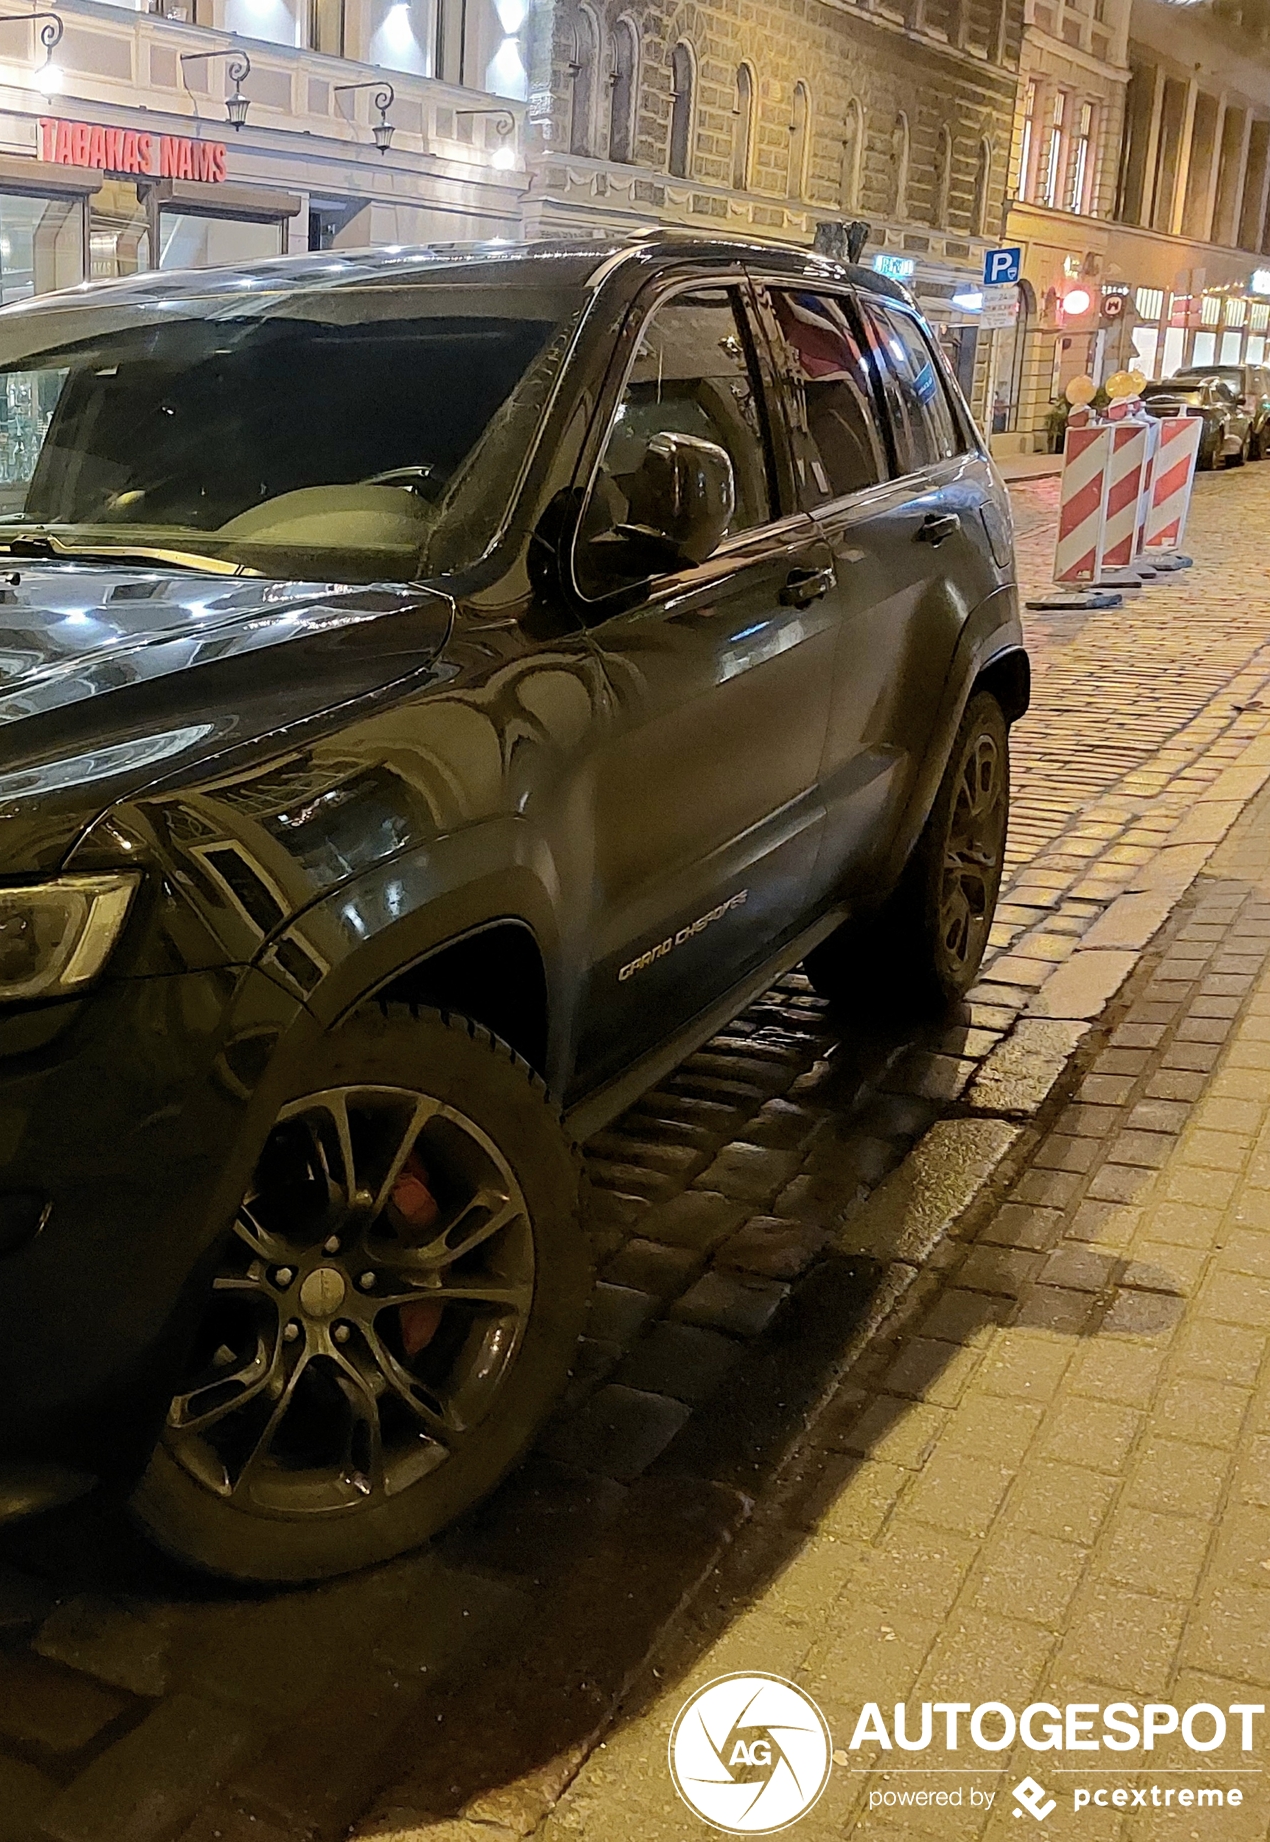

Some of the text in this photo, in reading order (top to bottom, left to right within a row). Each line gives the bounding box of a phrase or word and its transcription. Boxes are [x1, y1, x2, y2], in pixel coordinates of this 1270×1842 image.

[39, 117, 227, 183] TABAKAS NAMS
[991, 253, 1013, 281] P
[618, 937, 673, 981] GRAND
